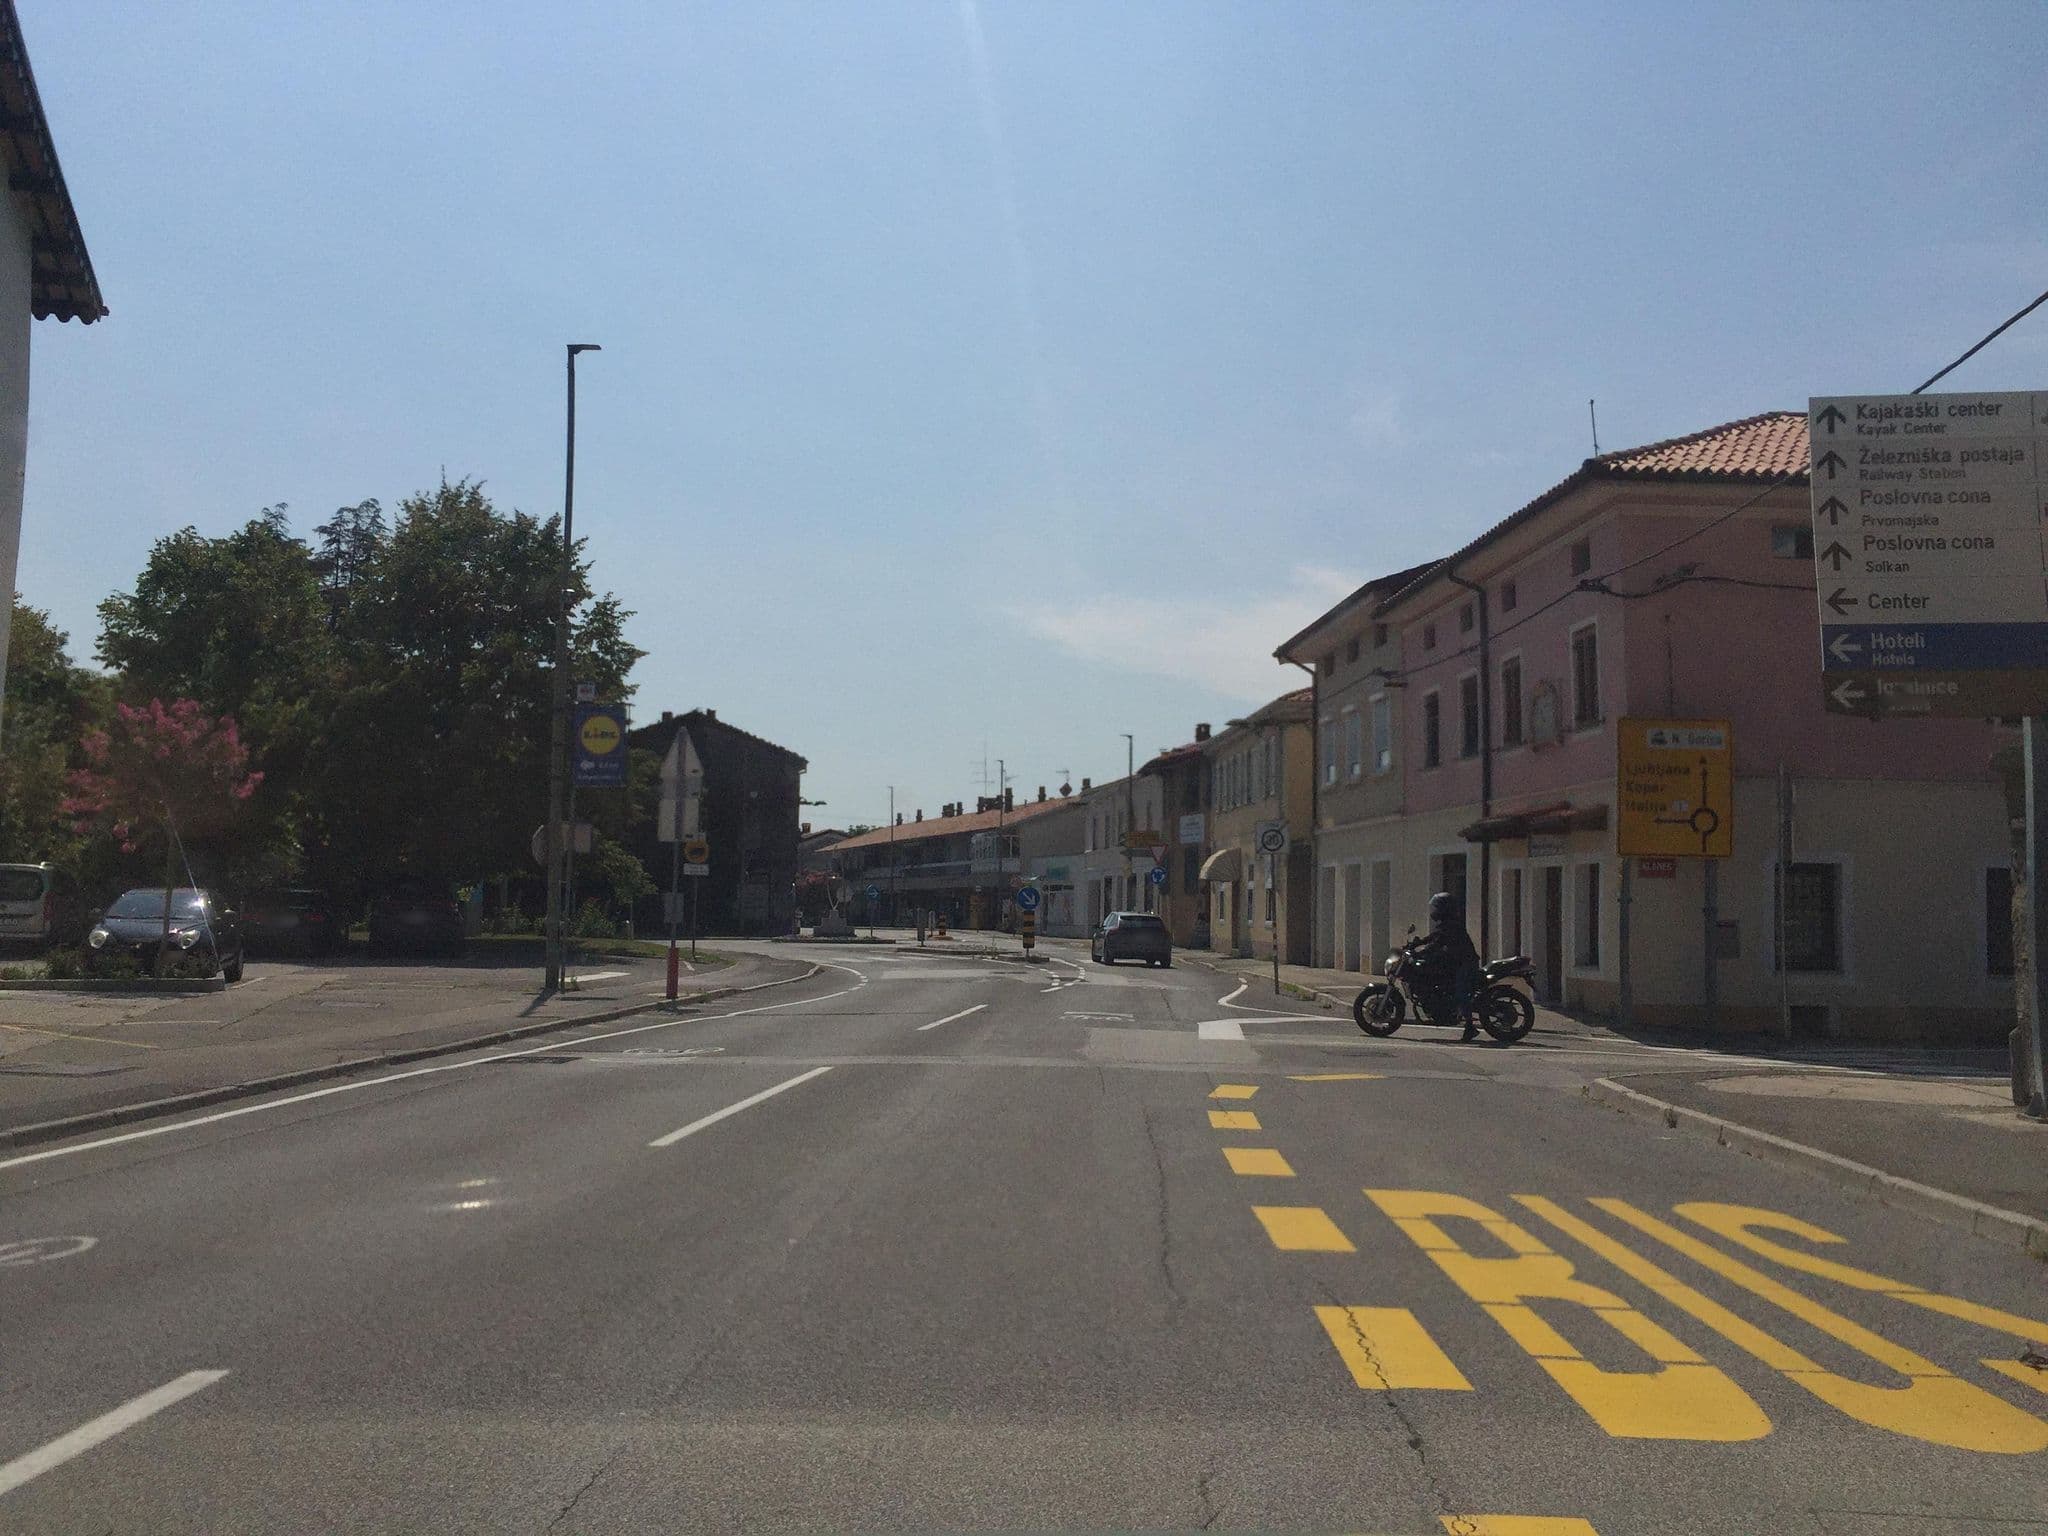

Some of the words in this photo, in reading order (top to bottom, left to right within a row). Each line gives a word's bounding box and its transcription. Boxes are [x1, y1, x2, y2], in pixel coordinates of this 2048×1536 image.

[1856, 403, 1939, 422] Kajakaški
[1948, 401, 2003, 418] center
[1857, 423, 1897, 438] Kayak
[1904, 422, 1948, 434] Center
[1859, 446, 1952, 465] Železniška
[1960, 447, 2025, 466] postaja
[1860, 469, 1913, 482] Railway
[1919, 467, 1967, 480] Station
[1860, 489, 1944, 506] Poslovna
[1948, 491, 1992, 505] cona
[1861, 514, 1940, 529] Prvomajska
[1863, 535, 1947, 551] Poslovna
[1951, 536, 1995, 550] cona
[1865, 560, 1910, 573] Solkan
[1868, 593, 1930, 609] Center
[1871, 632, 1926, 649] Hoteli
[1872, 653, 1915, 666] Hotels
